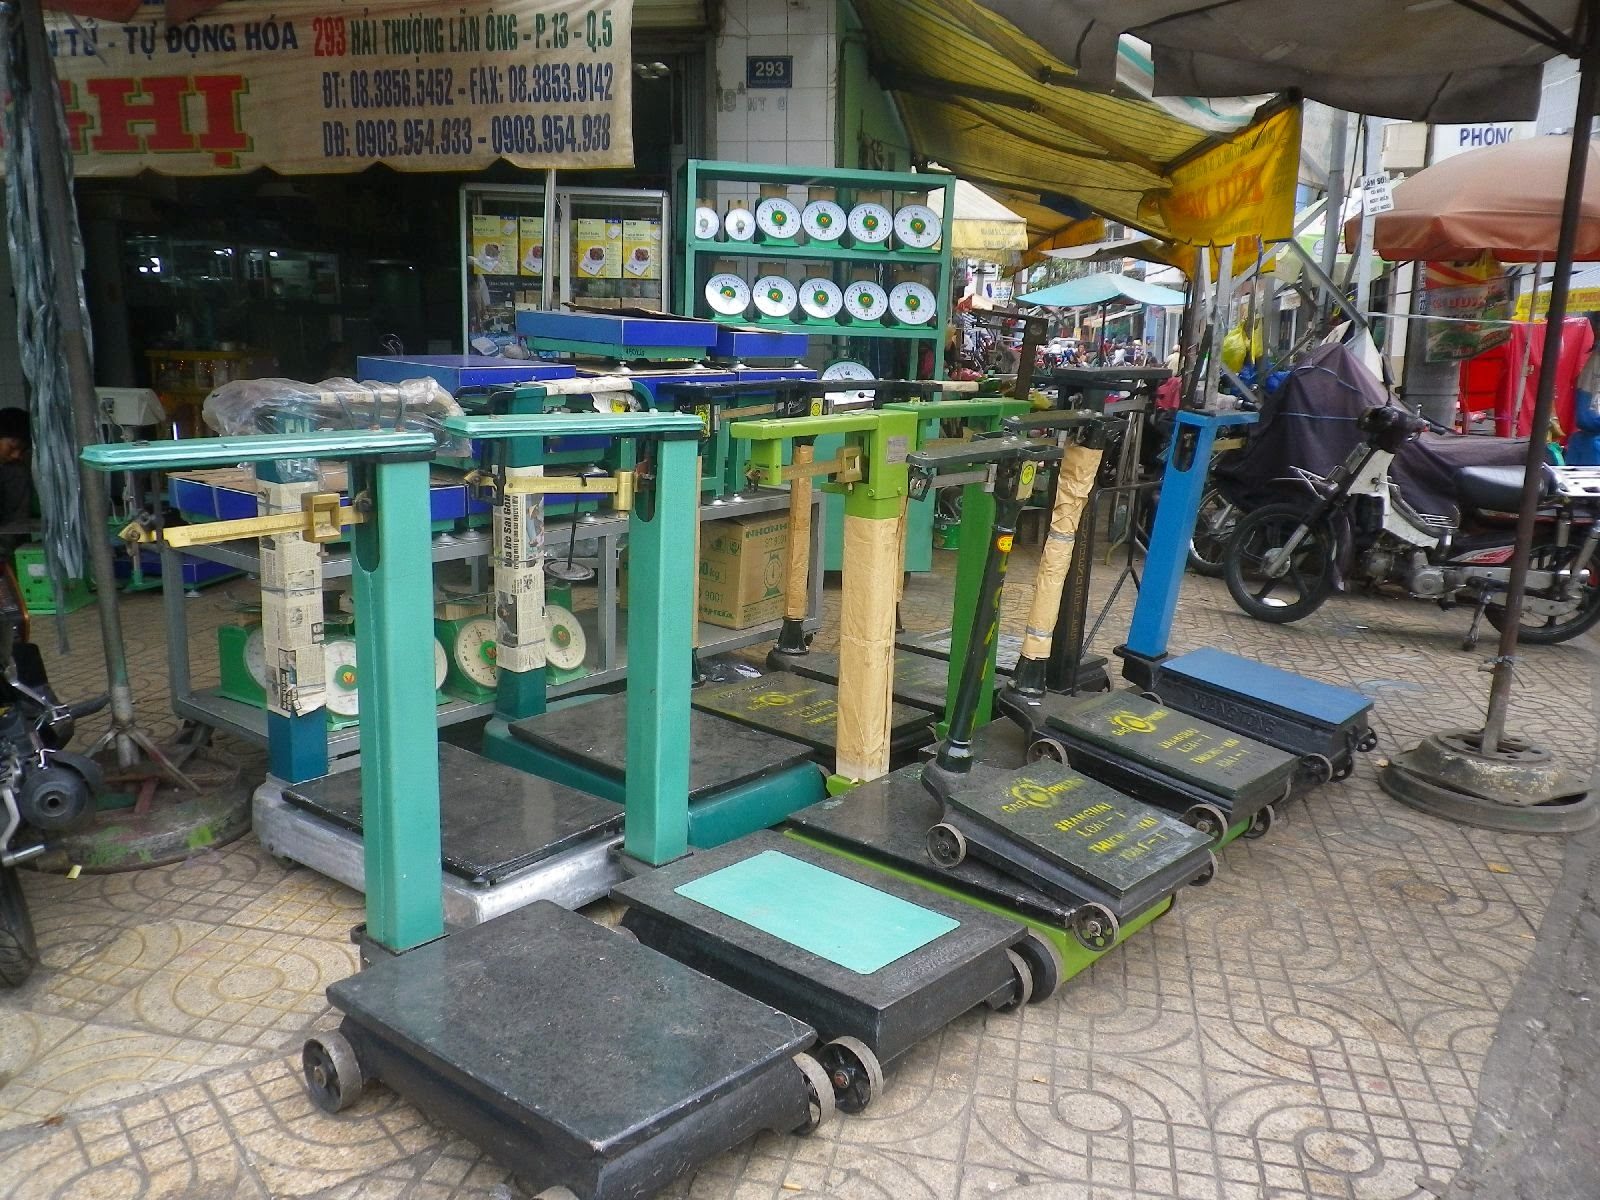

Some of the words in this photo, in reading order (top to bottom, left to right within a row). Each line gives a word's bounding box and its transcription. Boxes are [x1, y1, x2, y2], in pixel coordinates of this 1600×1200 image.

[122, 20, 159, 61] TỰ
[165, 18, 237, 59] ĐỘNG
[244, 14, 299, 51] HÓA
[312, 16, 347, 57] 293
[350, 7, 378, 56] HẢI
[382, 12, 444, 63] THƯỢNG
[449, 9, 480, 53] LÃN
[485, 7, 519, 51] ÔNG
[534, 12, 569, 50] P.13
[586, 9, 613, 53] Q.5
[322, 71, 347, 109] ĐT:
[349, 67, 454, 108] 08.3856.5452
[469, 65, 504, 105] FAX:
[507, 62, 614, 103] 08.3853.9142
[755, 61, 784, 77] 293
[354, 117, 473, 156] 0903.954.933
[491, 113, 611, 154] 0903.954.938
